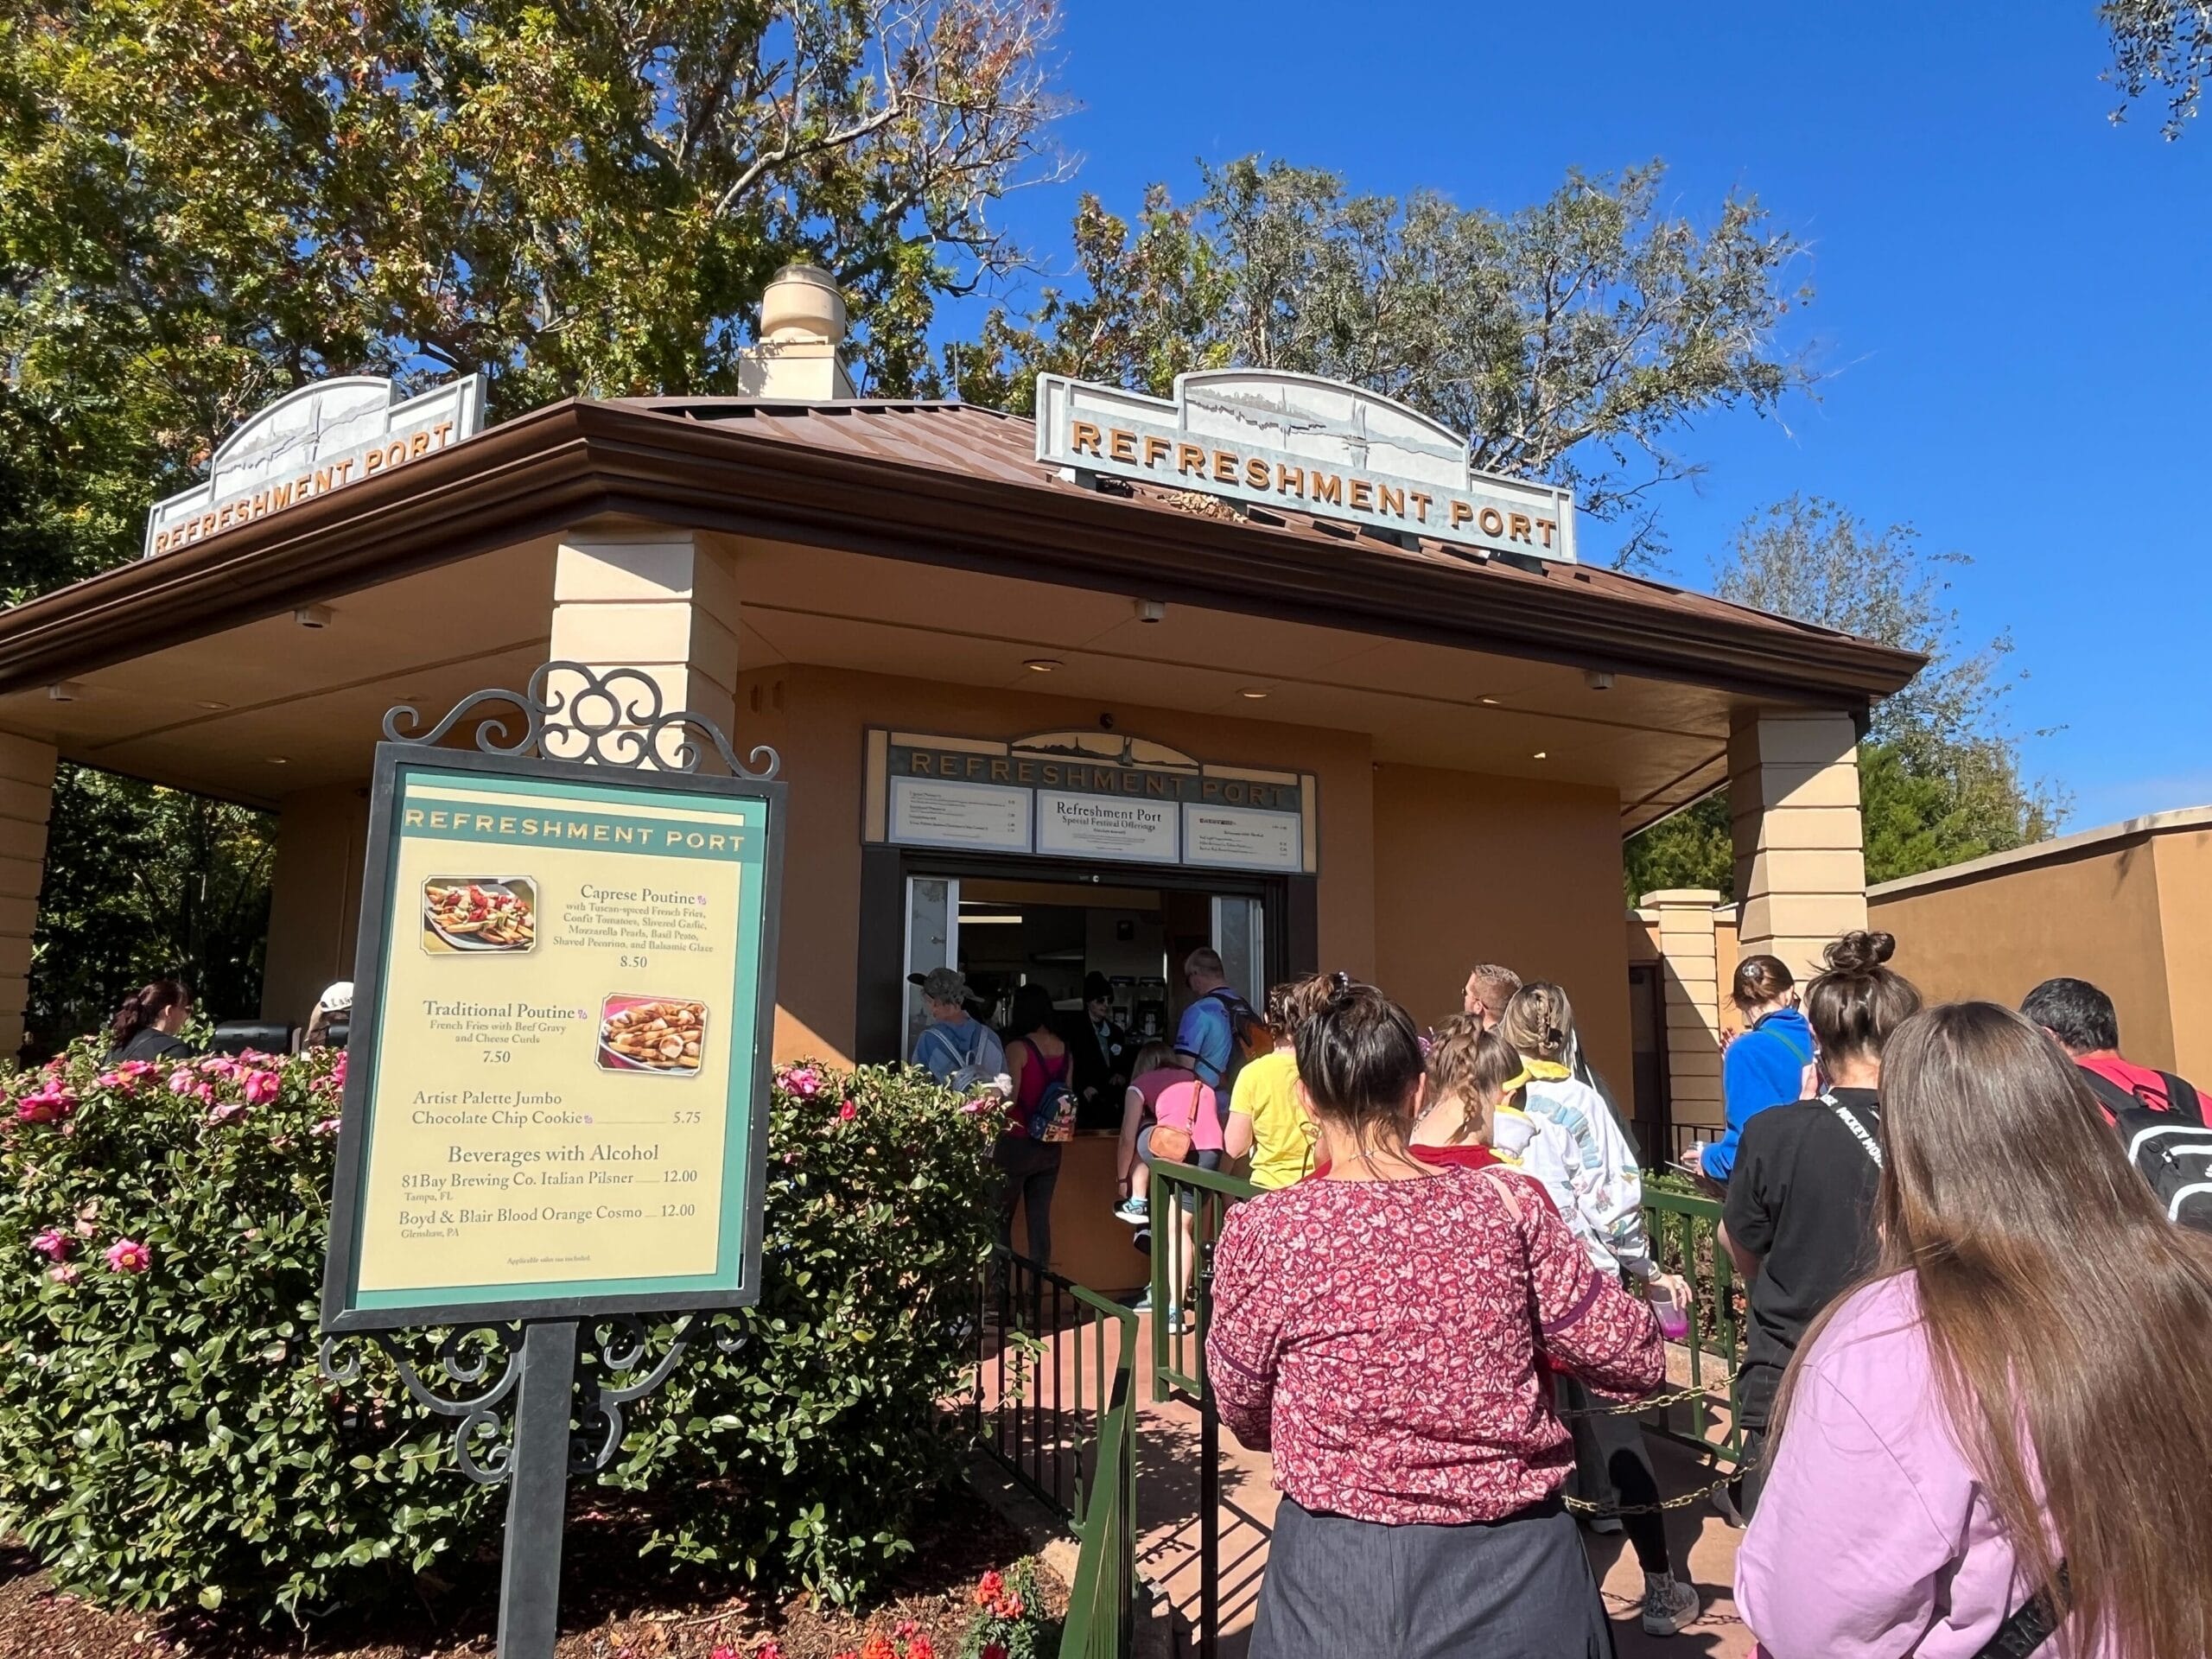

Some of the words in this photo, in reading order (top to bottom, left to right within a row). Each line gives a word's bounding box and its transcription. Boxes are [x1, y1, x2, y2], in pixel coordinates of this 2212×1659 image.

[155, 457, 354, 554] REFRESHMENT
[363, 420, 454, 476] PORT
[1071, 419, 1433, 522] REFRESHMENT
[1451, 499, 1557, 548] PORT
[911, 751, 1185, 798] REFRESHMENT
[1202, 779, 1282, 808] PORT
[1057, 800, 1134, 821] Refreshment
[1137, 808, 1162, 823] Port
[404, 808, 654, 845] REFRESHMENT
[665, 830, 746, 853] PORT
[1062, 815, 1090, 827] Special
[1090, 817, 1120, 828] Festival
[1121, 820, 1156, 833] Offerings
[581, 884, 638, 904] Caprese
[642, 887, 696, 905] Poutine
[566, 901, 586, 912] with
[588, 902, 650, 917] Tuscan-spiced
[652, 906, 681, 917] French
[683, 907, 706, 918] Fries,
[563, 912, 594, 924] Confit
[595, 914, 640, 927] Tomatoes,
[642, 917, 676, 928] Slivered
[677, 918, 708, 931] Garlic,
[569, 924, 618, 937] Mozzarella
[620, 927, 648, 939] Pearls,
[651, 929, 672, 939] Basil
[674, 930, 699, 942] Pesto,
[553, 936, 585, 947] Shaved
[588, 938, 629, 950] Pecorino,
[630, 940, 646, 950] and
[649, 940, 687, 951] Balsamic
[620, 955, 648, 969] 8.50
[423, 1000, 512, 1019] Traditional
[517, 1003, 575, 1020] Poutine
[430, 1020, 463, 1031] French
[466, 1020, 489, 1031] Fries
[492, 1021, 512, 1032] with
[515, 1021, 536, 1033] Beef
[537, 1022, 567, 1035] Gravy
[455, 1033, 473, 1043] and
[475, 1033, 510, 1044] Cheese
[512, 1034, 541, 1045] Curds
[482, 1050, 511, 1064] 7.50
[413, 1090, 459, 1105] Artist
[462, 1090, 512, 1105] Palette
[512, 1090, 563, 1108] Jumbo
[412, 1110, 488, 1125] Chocolate
[492, 1110, 528, 1128] Chip
[531, 1110, 582, 1125] Cookie
[672, 1111, 702, 1124] 5.75
[1835, 1106, 1871, 1140] MICKEY
[1861, 1137, 1883, 1169] MOU
[448, 1145, 541, 1167] Beverages
[545, 1145, 585, 1162] with
[589, 1143, 659, 1161] Alcohol
[402, 1173, 447, 1192] 81Bay
[451, 1173, 510, 1191] Brewing
[512, 1172, 537, 1186] Co.
[541, 1170, 584, 1185] Italian
[588, 1170, 634, 1185] Pilsner
[663, 1169, 698, 1183] 12.00
[404, 1192, 437, 1204] Tampa,
[440, 1192, 454, 1201] FL
[399, 1210, 435, 1229] Boyd
[439, 1210, 455, 1224] &
[460, 1209, 493, 1224] Blair
[498, 1207, 538, 1222] Blood
[542, 1206, 593, 1224] Orange
[596, 1205, 642, 1219] Cosmo
[661, 1203, 696, 1217] 12.00
[401, 1228, 445, 1239] Glenshaw,
[446, 1228, 460, 1237] PA
